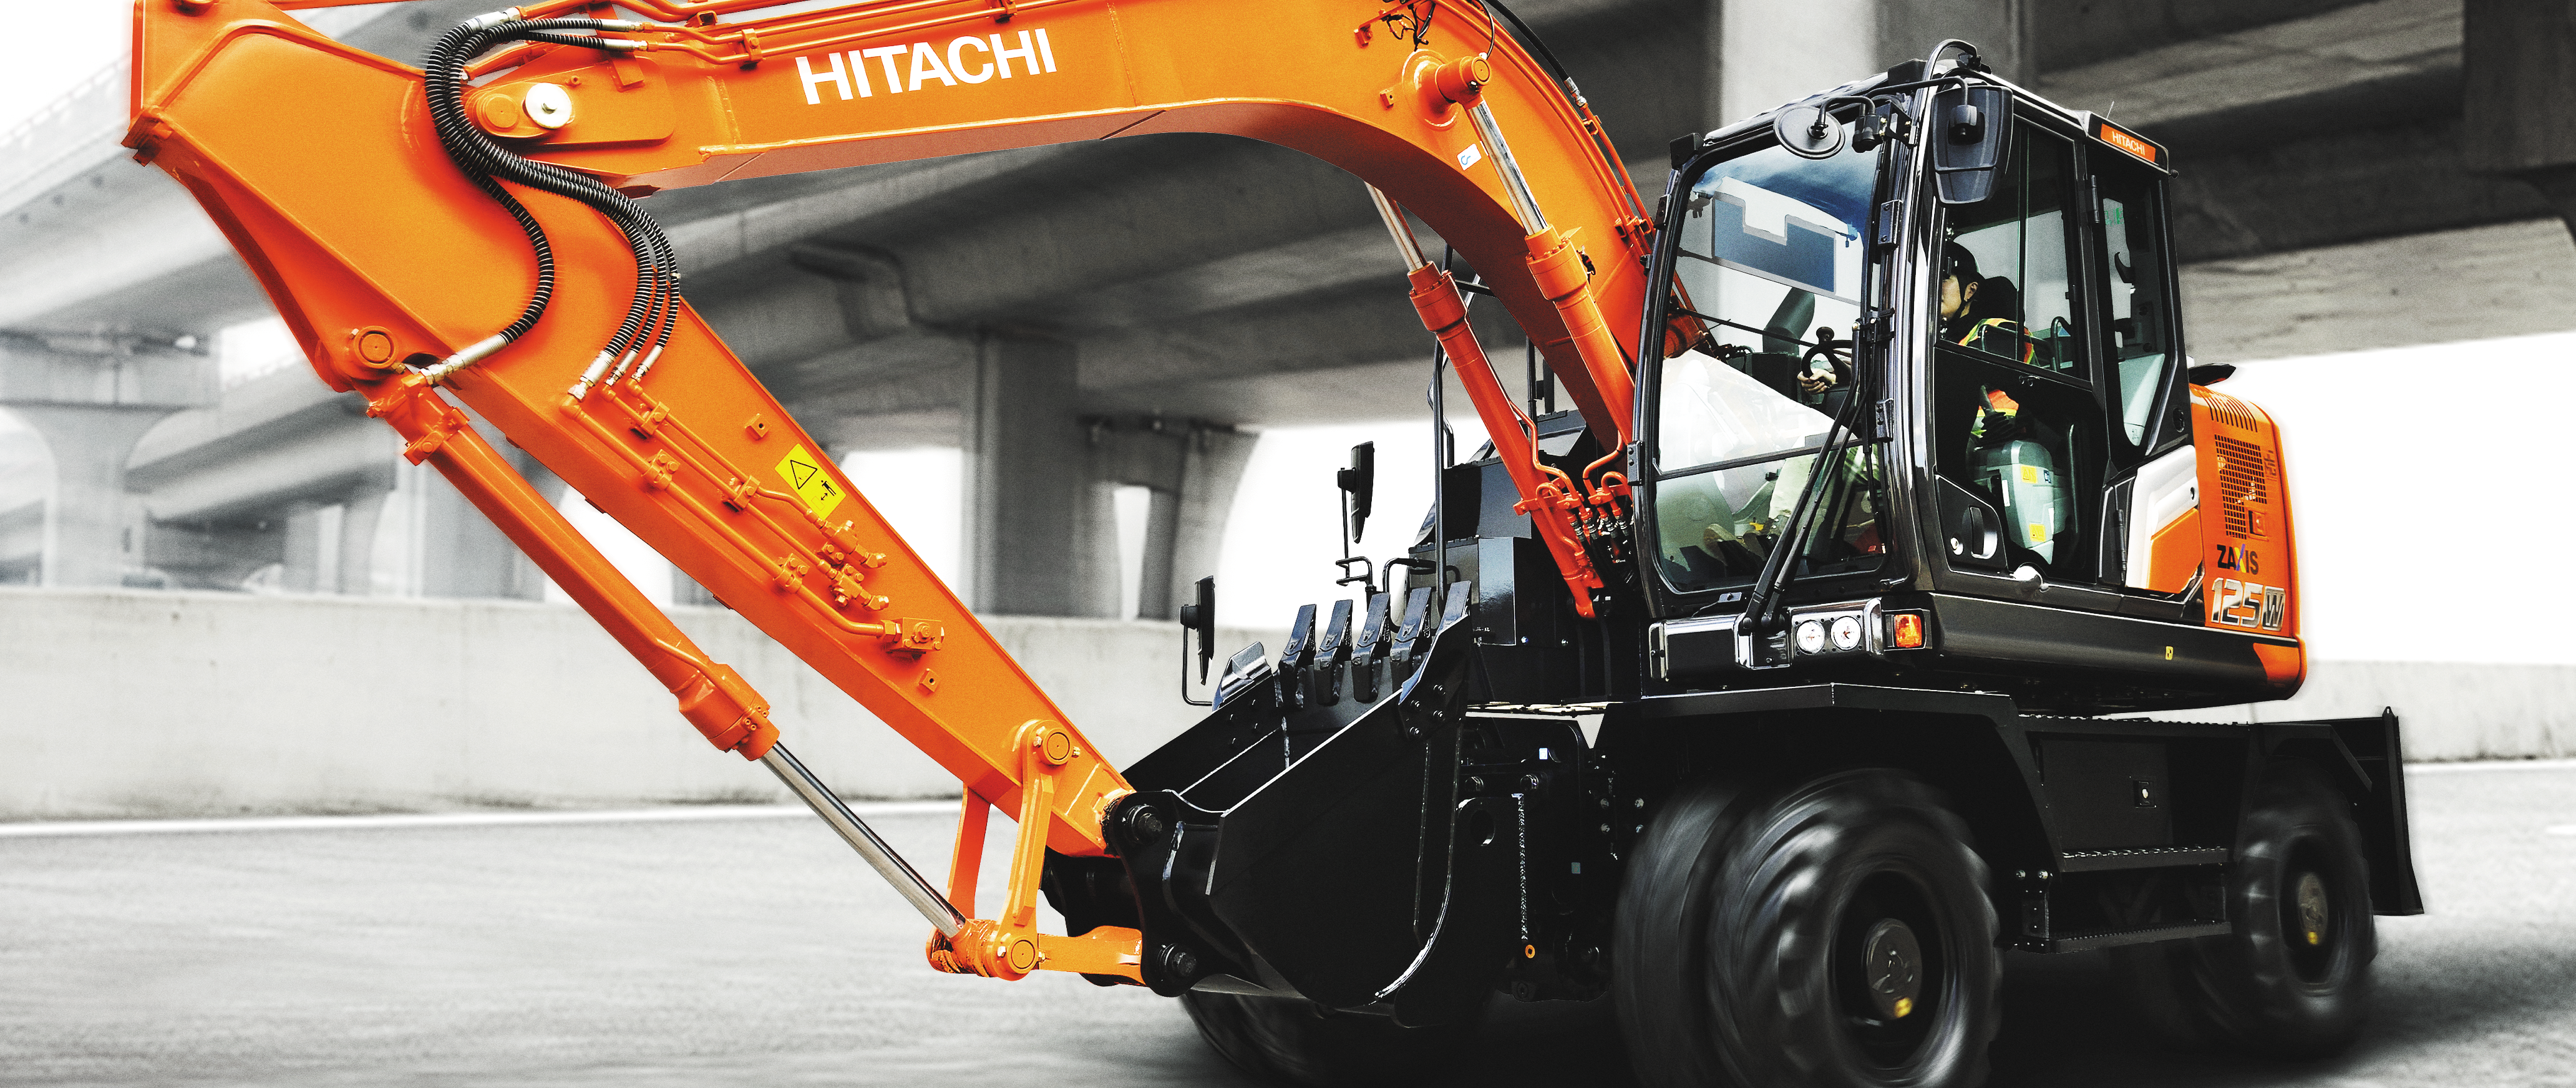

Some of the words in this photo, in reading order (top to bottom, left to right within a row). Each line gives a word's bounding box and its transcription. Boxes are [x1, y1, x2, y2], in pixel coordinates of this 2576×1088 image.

[795, 28, 1057, 105] HITACHI
[2112, 130, 2146, 155] HITACHI
[2217, 543, 2259, 575] ZAXIS
[2211, 577, 2286, 632] 125W
